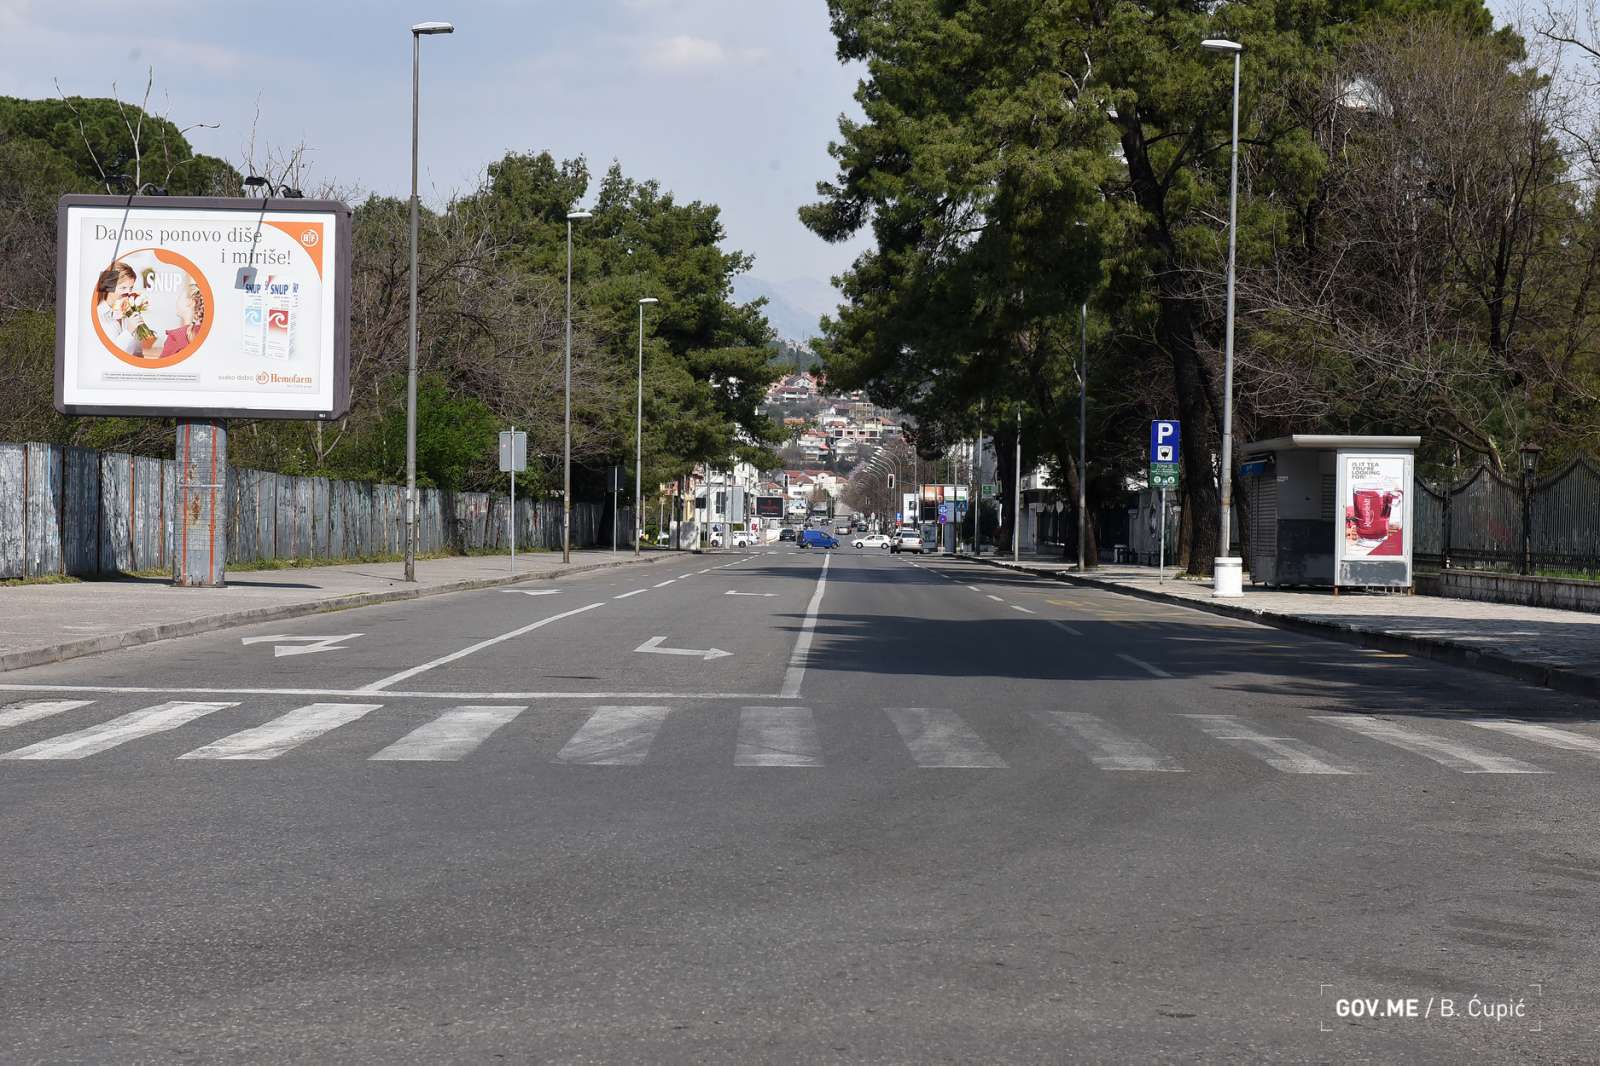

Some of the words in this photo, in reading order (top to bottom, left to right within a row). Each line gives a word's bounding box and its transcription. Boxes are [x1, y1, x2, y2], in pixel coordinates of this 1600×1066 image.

[95, 224, 117, 241] Da
[124, 228, 153, 241] nos
[160, 229, 221, 245] ponovo
[227, 226, 263, 243] diše
[221, 248, 225, 264] i
[232, 248, 291, 265] miriše!
[146, 271, 182, 292] SNUP
[270, 283, 289, 295] SNUP
[271, 373, 312, 384] Hemofarm
[1158, 423, 1173, 444] P
